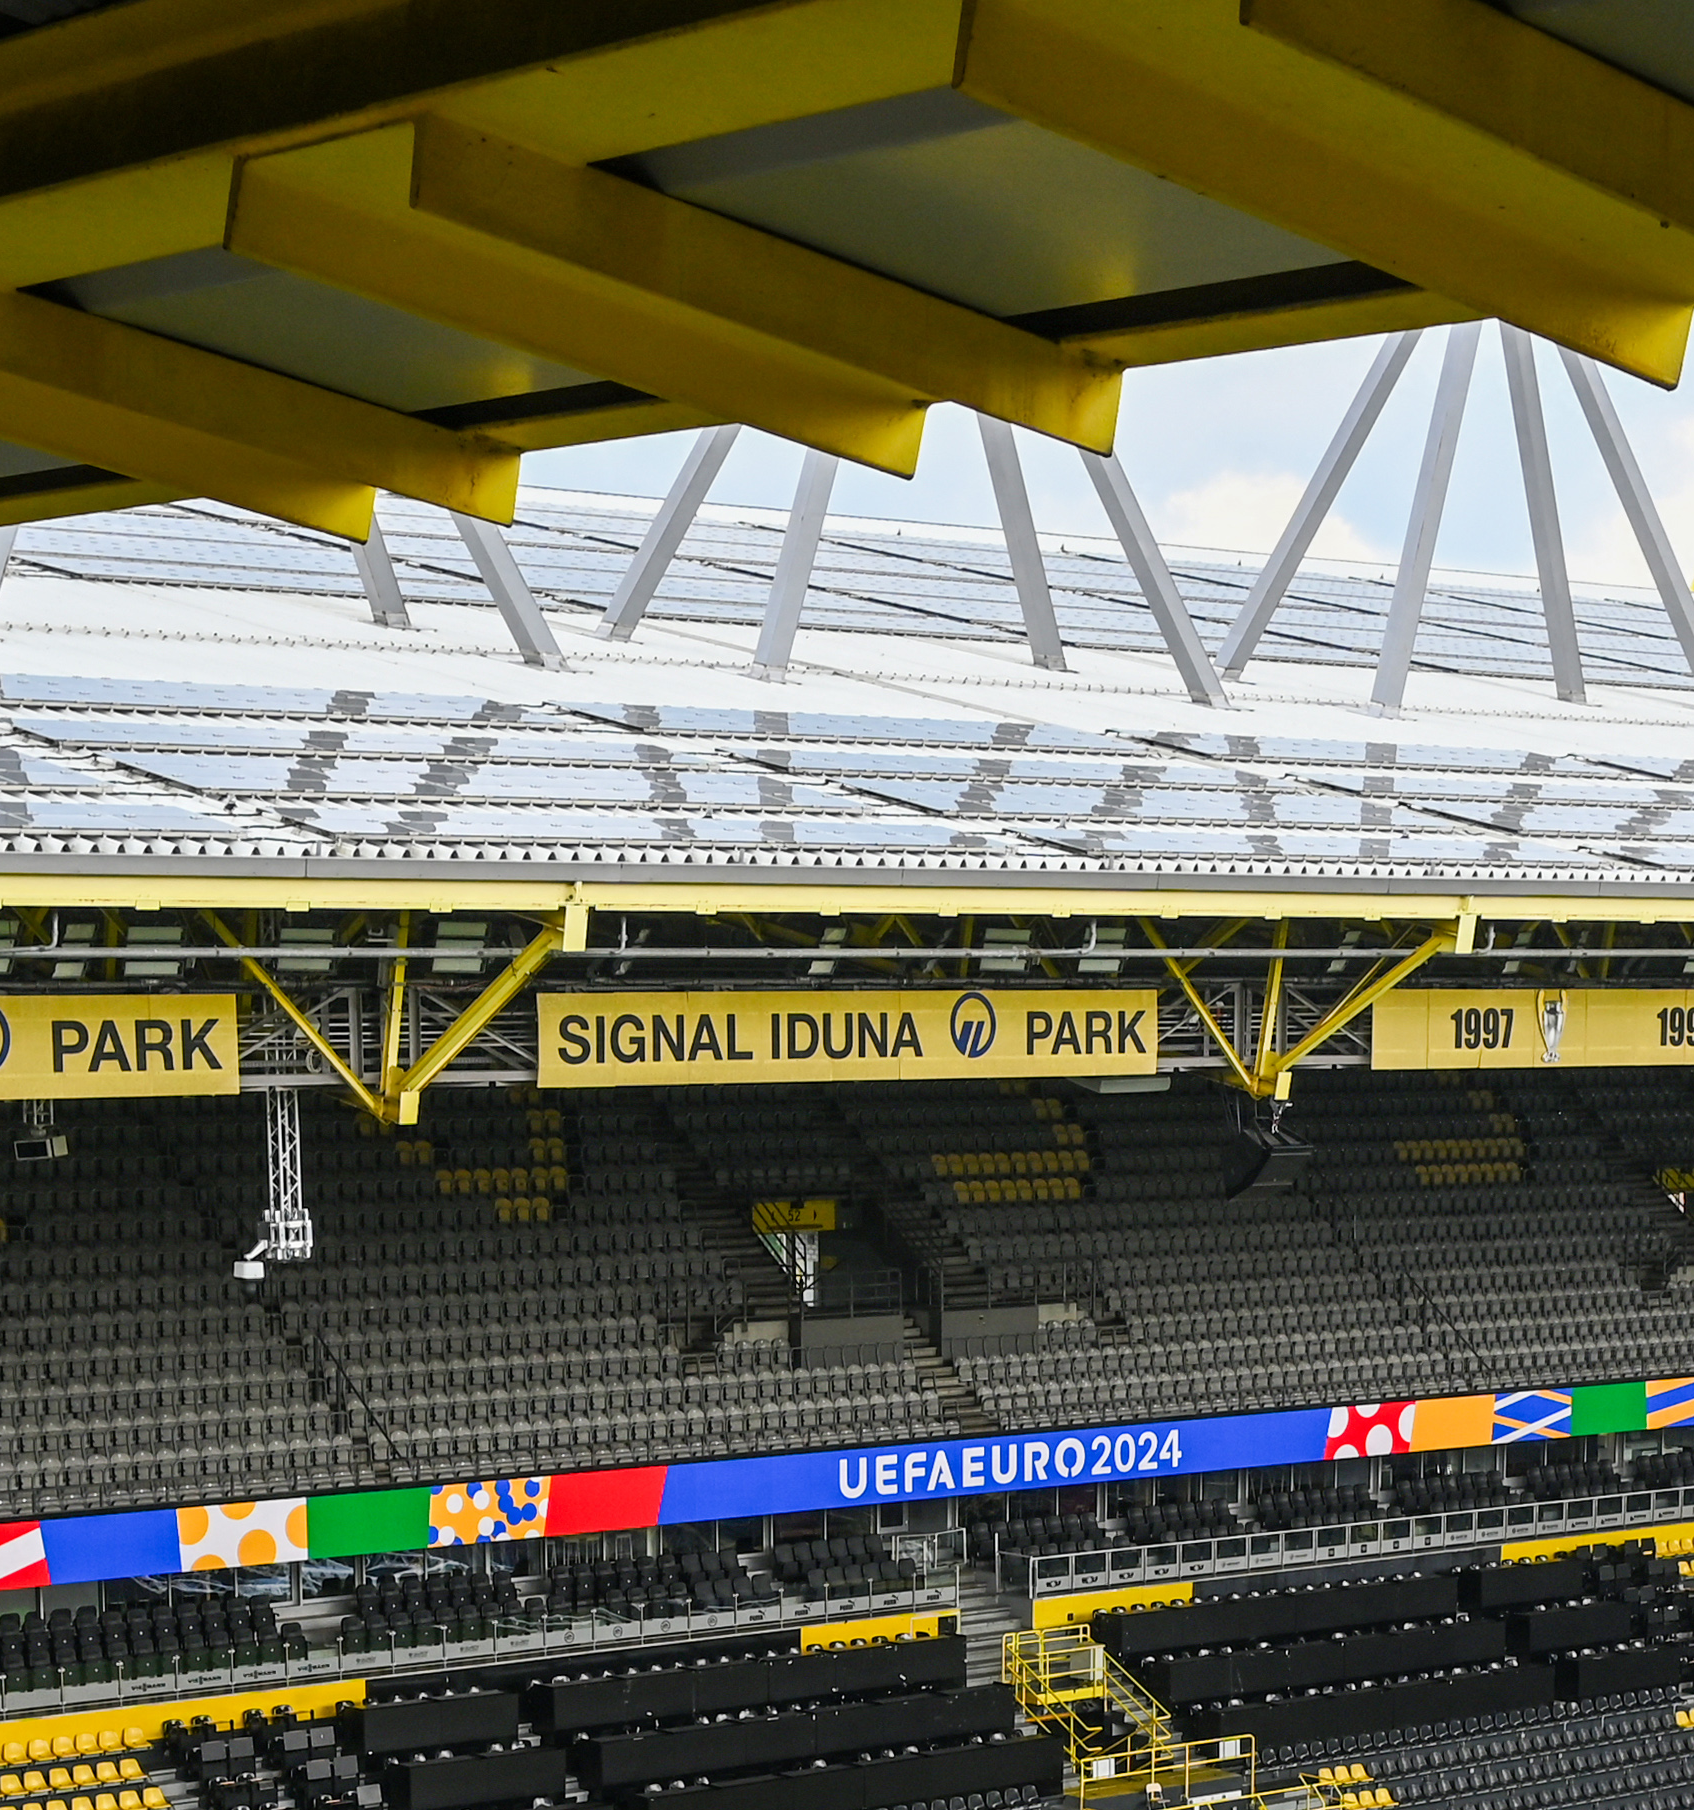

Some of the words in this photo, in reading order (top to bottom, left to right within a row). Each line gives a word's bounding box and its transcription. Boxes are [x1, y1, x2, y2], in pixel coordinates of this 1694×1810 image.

[51, 1018, 223, 1073] PARK
[558, 1012, 753, 1064] SIGNAL
[771, 1011, 923, 1061] IDUNA
[1026, 1009, 1146, 1056] PARK
[1451, 1008, 1514, 1051] 1997
[788, 1210, 800, 1221] 52
